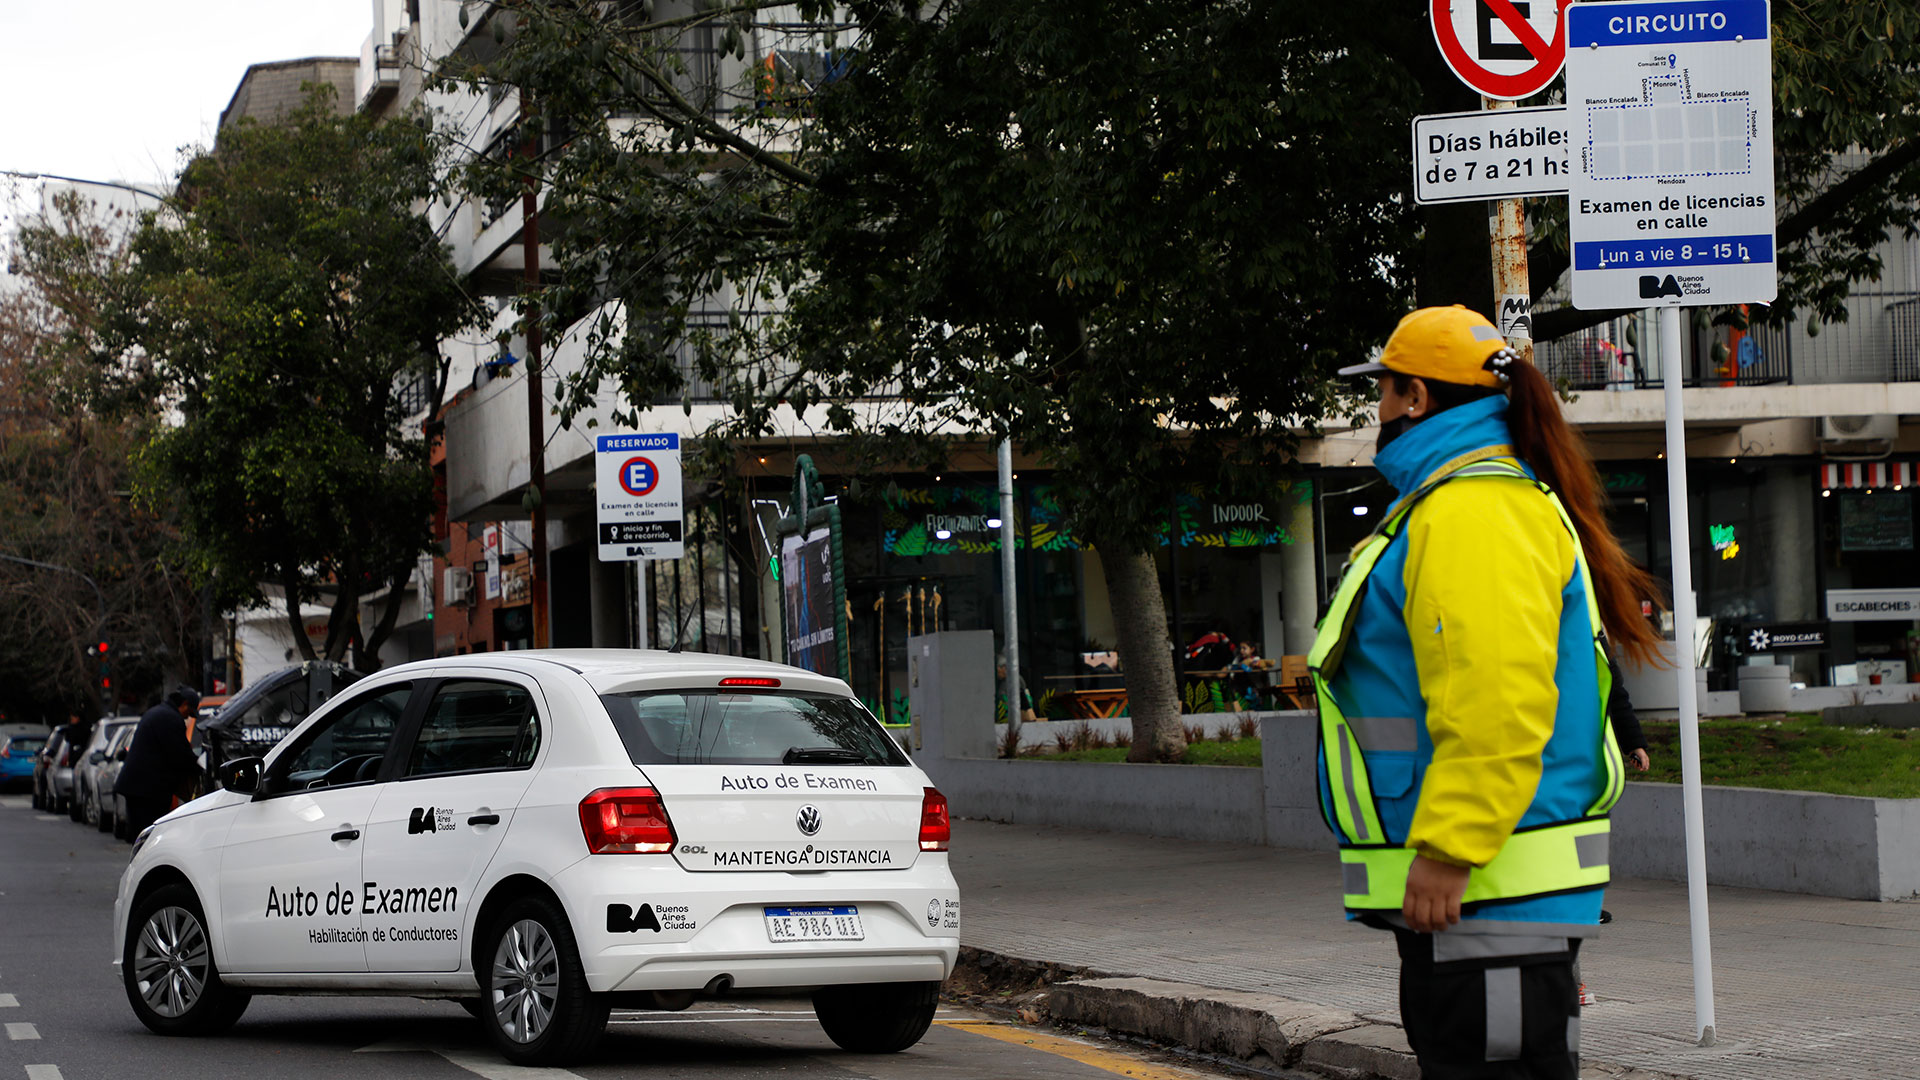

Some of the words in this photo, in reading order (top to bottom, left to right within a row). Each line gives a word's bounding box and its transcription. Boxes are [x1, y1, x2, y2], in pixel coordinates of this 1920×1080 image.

[1608, 12, 1727, 35] CIRCUITO
[1683, 68, 1692, 99] Holmberg
[1609, 96, 1638, 104] Encalada
[1429, 133, 1482, 154] Días
[1426, 164, 1457, 184] de
[1464, 162, 1477, 180] 7
[1485, 164, 1499, 179] a
[1507, 157, 1532, 178] 21
[1580, 199, 1652, 214] Examen
[1658, 196, 1680, 211] de
[1686, 193, 1766, 210] licencias
[1636, 218, 1658, 230] en
[1664, 213, 1708, 229] calle
[1600, 248, 1629, 263] Lun
[1634, 250, 1645, 262] a
[1650, 246, 1674, 261] vie
[1681, 245, 1692, 260] 8
[1712, 243, 1732, 259] 15
[1738, 243, 1749, 260] h
[1639, 274, 1683, 299] BA
[1684, 287, 1711, 295] Ciudad
[607, 438, 669, 448] RESERVADO
[629, 464, 648, 489] E
[601, 501, 632, 510] Examen
[1213, 503, 1270, 524] INDOOR
[635, 532, 670, 540] recorrido
[1835, 601, 1911, 612] ESCABECHES
[1798, 632, 1821, 641] CAFÉ
[721, 774, 769, 791] Auto
[775, 773, 800, 788] de
[803, 773, 878, 791] Examen
[435, 807, 454, 815] Buenos
[437, 815, 451, 823] Aires
[438, 822, 456, 831] Ciudad
[680, 845, 709, 854] GOL
[714, 850, 810, 866] MANTENGA
[814, 849, 892, 864] DISTANCIA
[265, 885, 319, 918] Auto
[325, 882, 355, 916] de
[361, 882, 458, 915] Examen
[656, 905, 689, 913] Buenos
[661, 913, 686, 921] Aires
[607, 903, 661, 933] BA
[664, 921, 696, 929] Ciudad
[308, 927, 369, 944] Habilitación
[372, 927, 386, 943] de
[389, 925, 458, 942] Conductores
[773, 917, 796, 937] AE
[798, 917, 832, 937] 986
